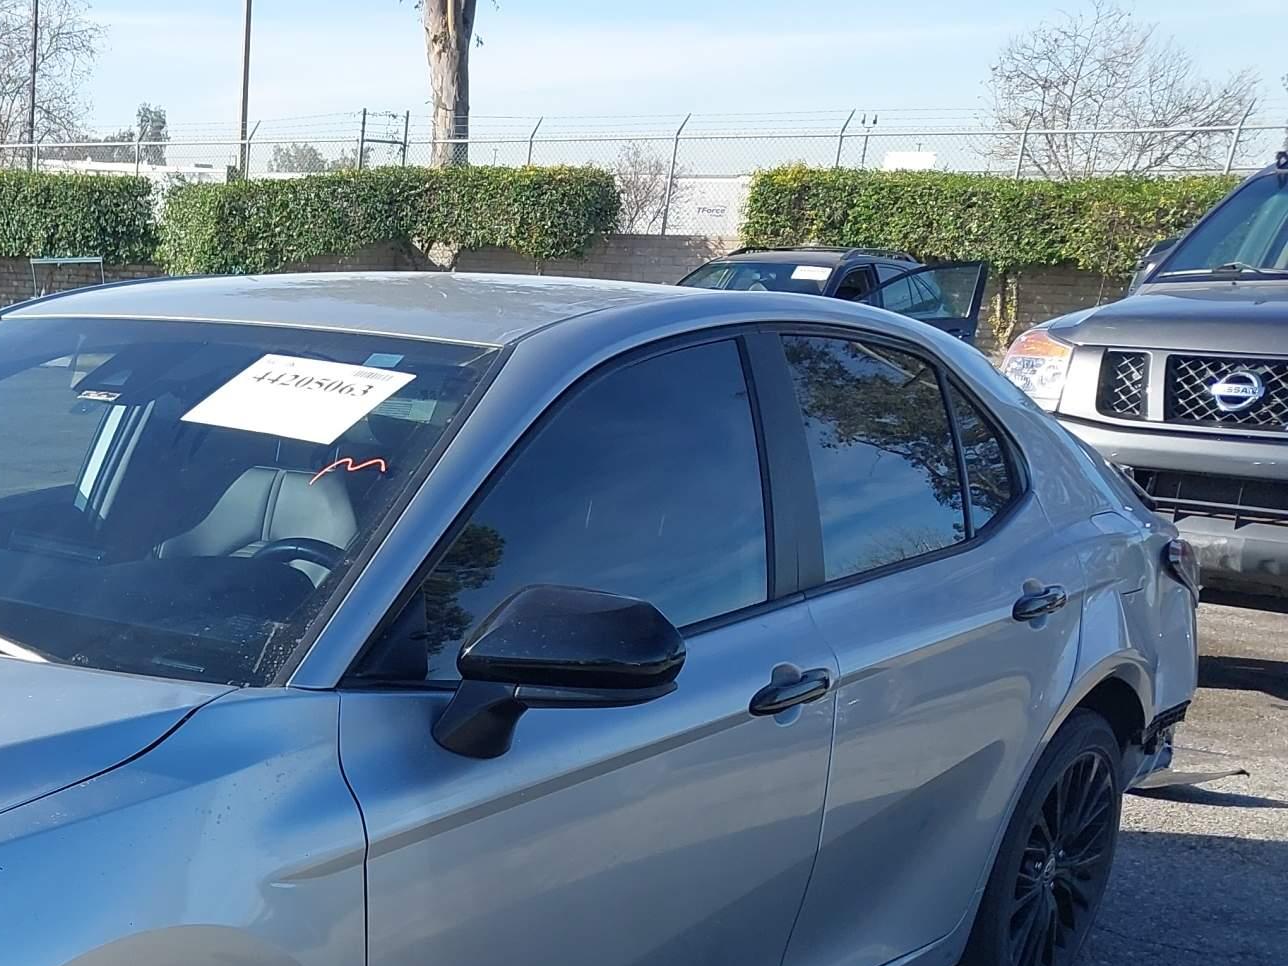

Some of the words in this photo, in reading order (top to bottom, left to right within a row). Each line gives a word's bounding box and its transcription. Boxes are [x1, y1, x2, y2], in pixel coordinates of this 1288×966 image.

[697, 206, 726, 214] TForce
[251, 370, 375, 397] 44205063
[1214, 385, 1257, 395] SSAN
